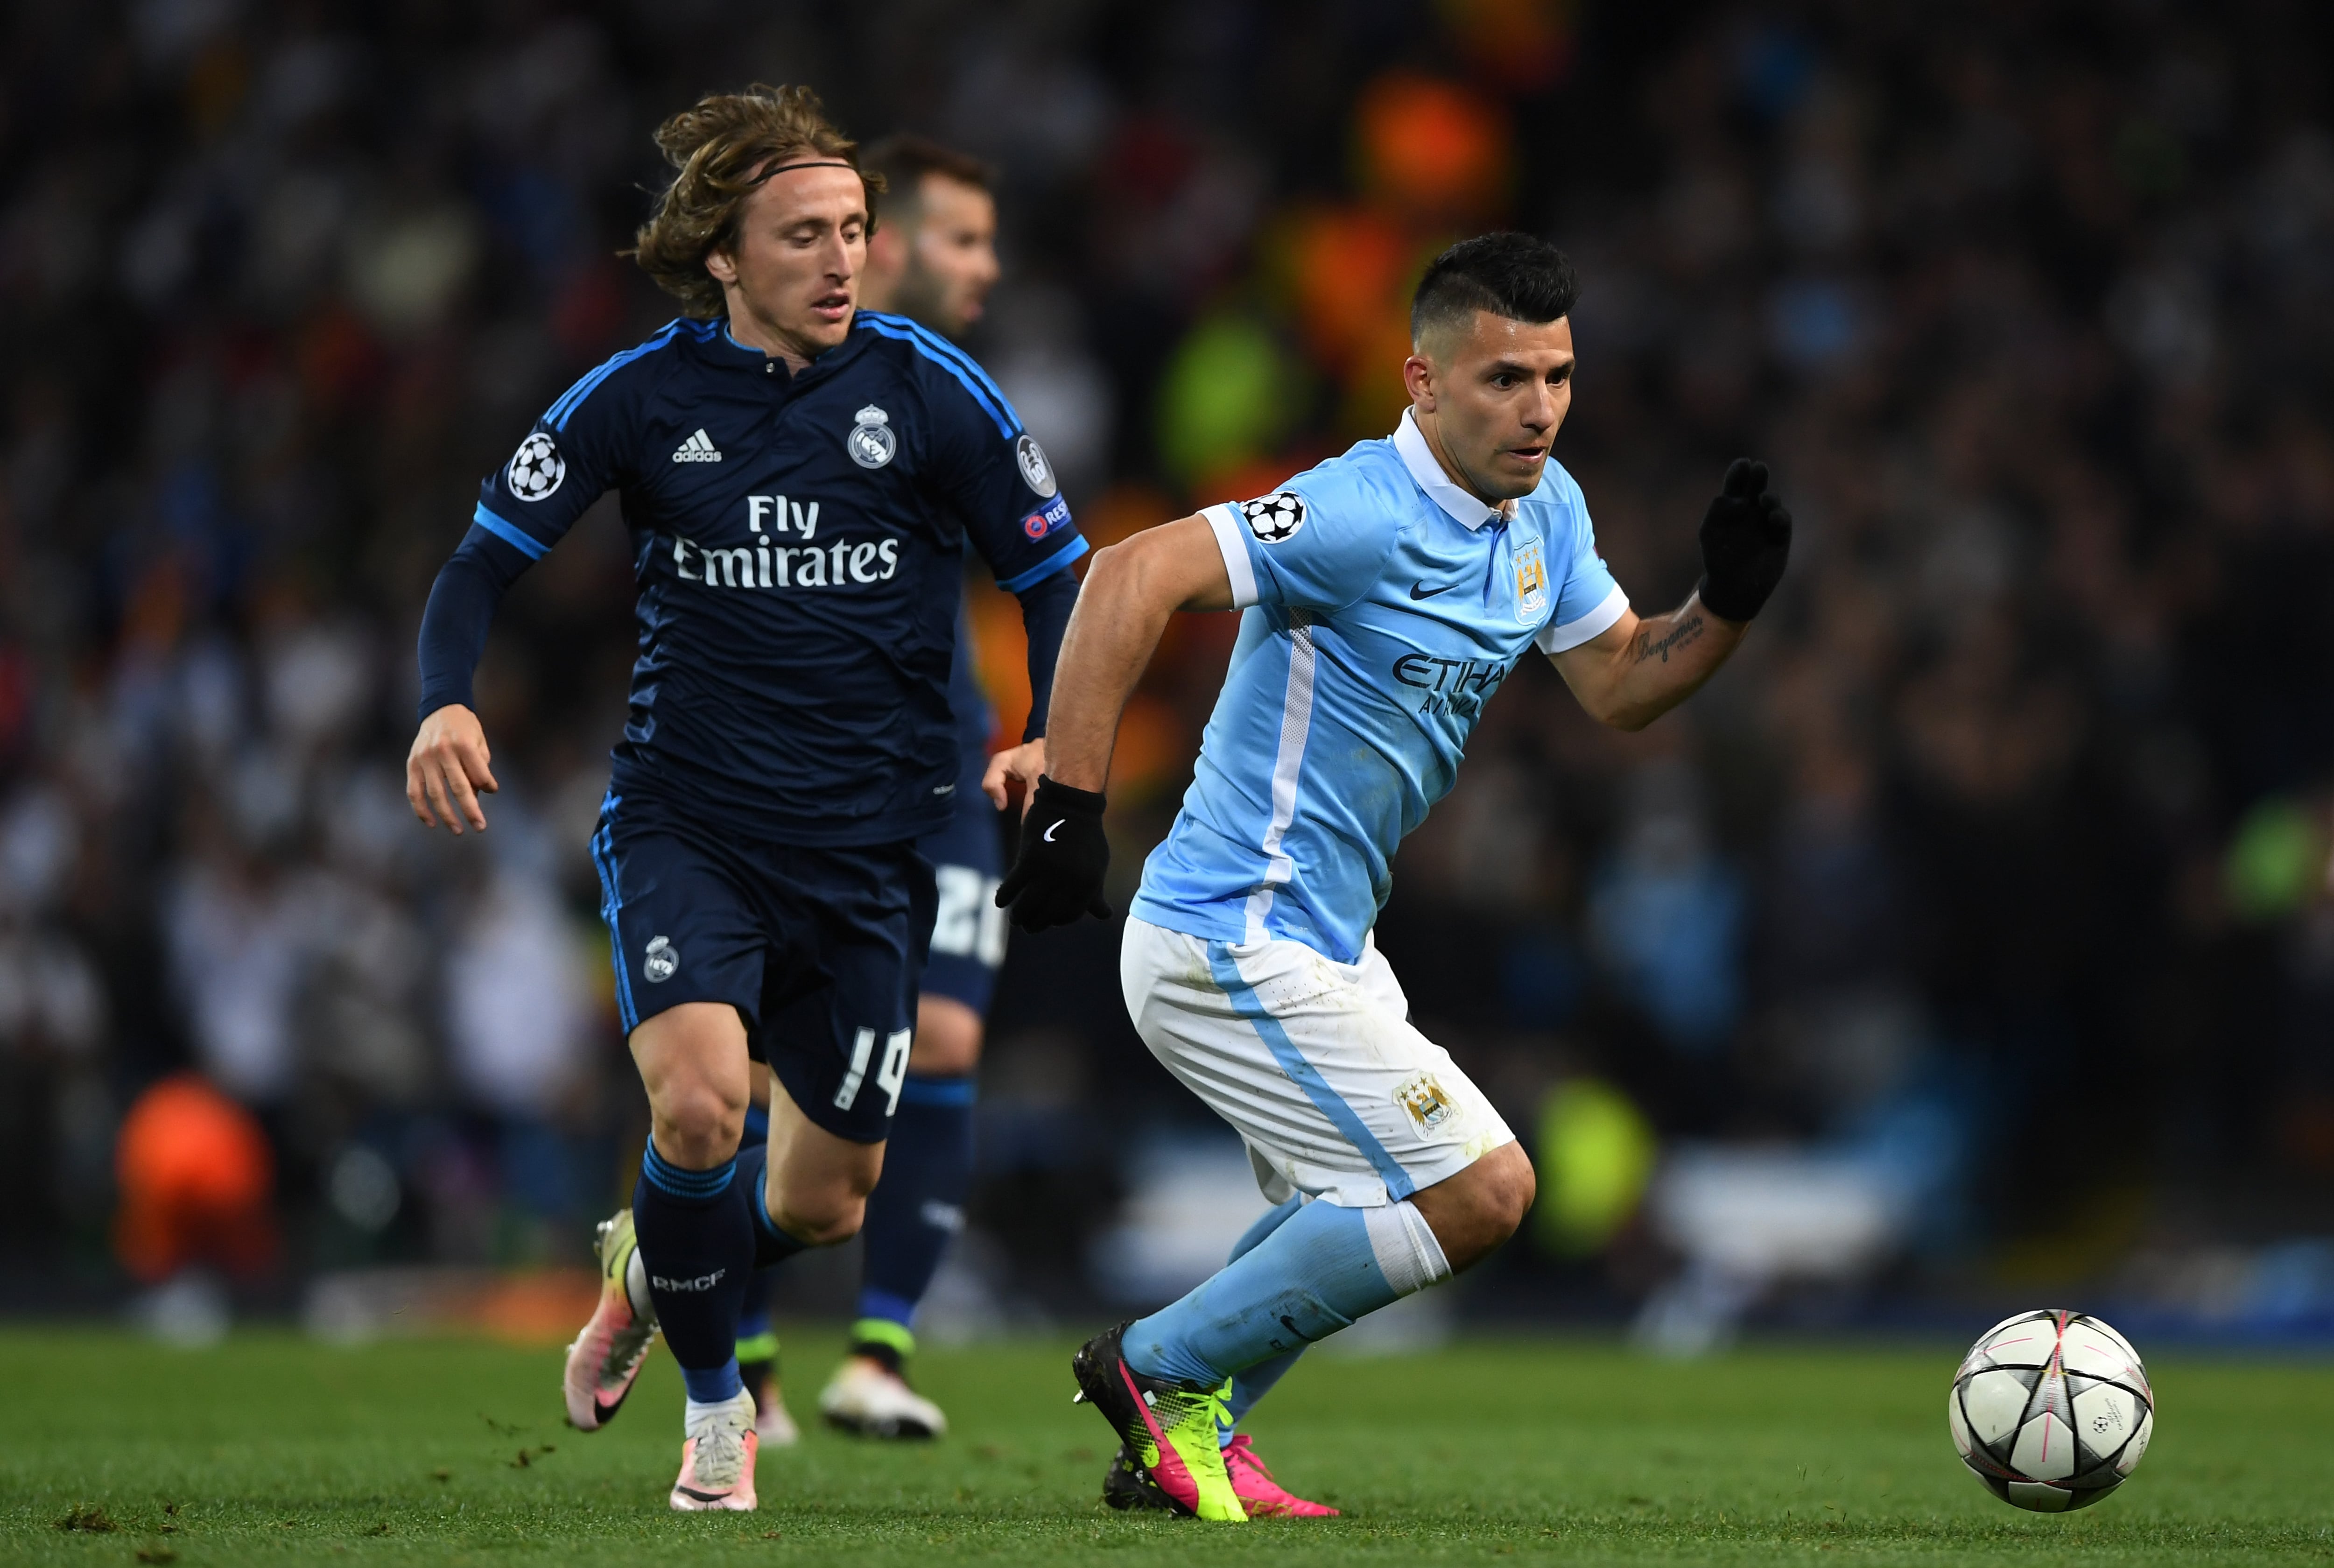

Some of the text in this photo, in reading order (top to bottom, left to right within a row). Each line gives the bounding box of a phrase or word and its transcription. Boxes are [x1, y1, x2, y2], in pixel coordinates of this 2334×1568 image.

[672, 448, 722, 463] adidas
[747, 495, 819, 540] Fly
[1045, 500, 1068, 525] RES
[673, 534, 899, 588] Emirates
[1392, 653, 1506, 693] ETIHA
[1418, 696, 1486, 717] AIRWA
[652, 1267, 726, 1292] RMCF
